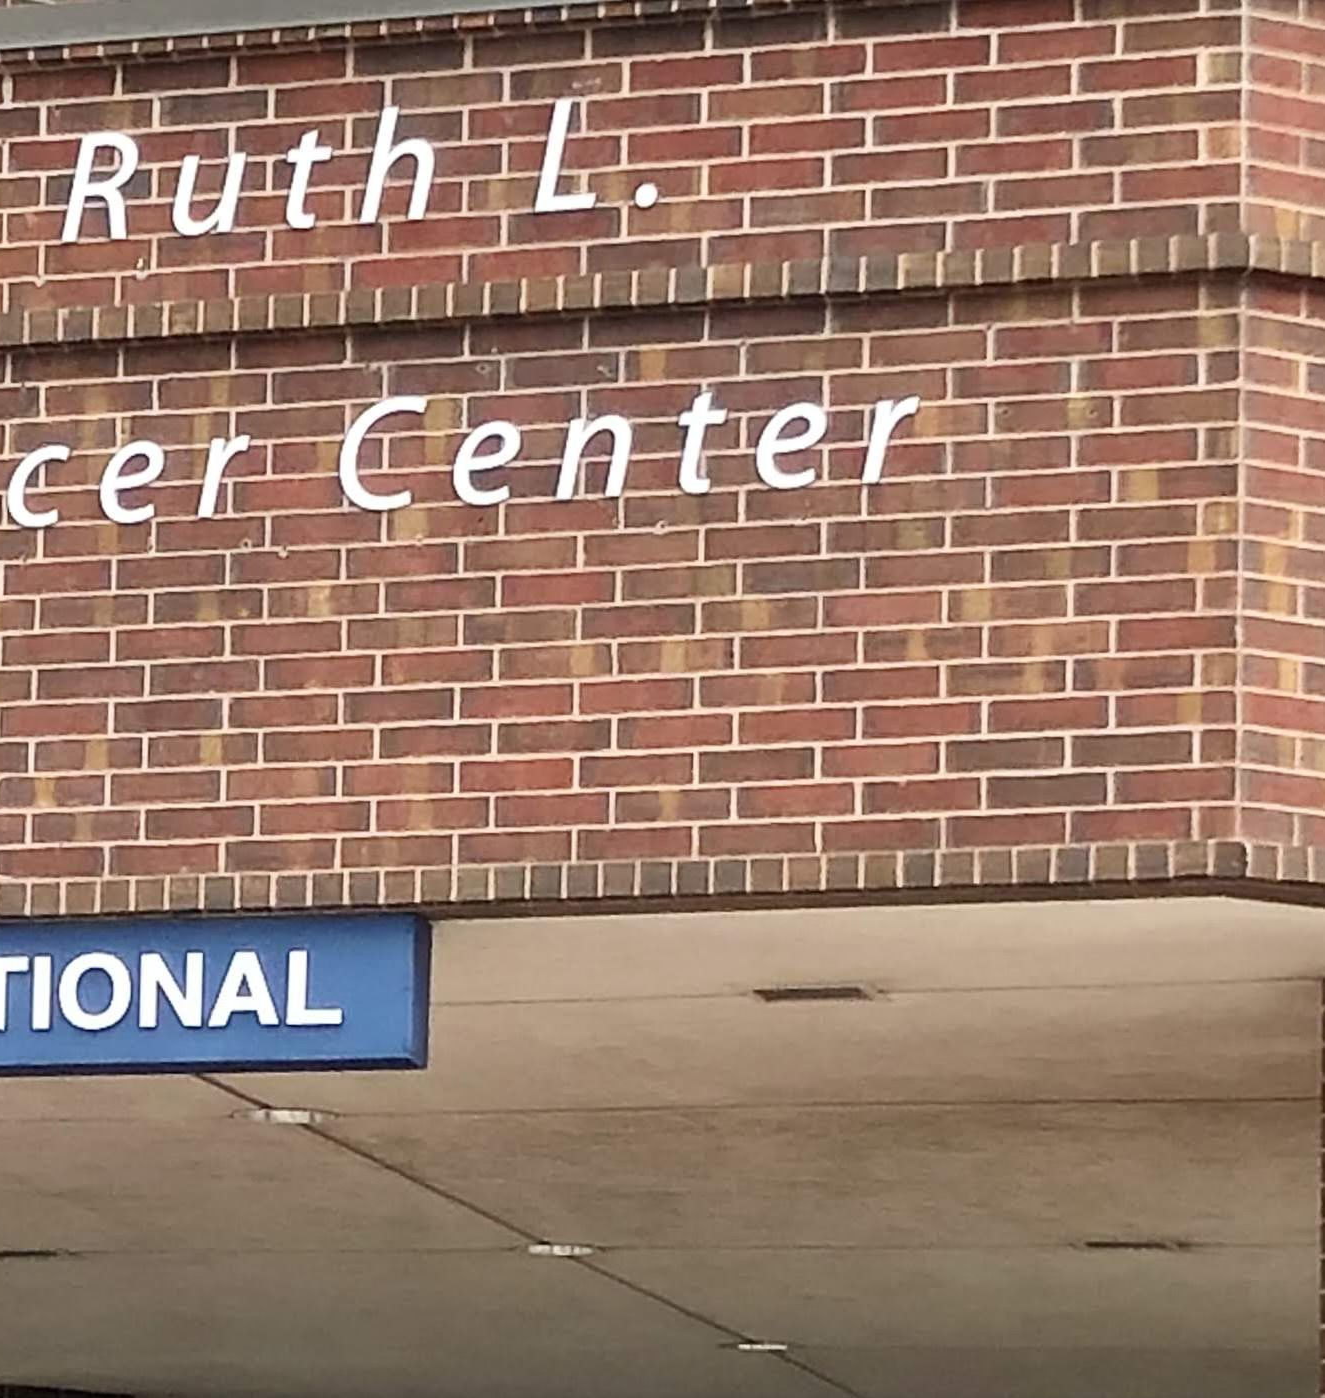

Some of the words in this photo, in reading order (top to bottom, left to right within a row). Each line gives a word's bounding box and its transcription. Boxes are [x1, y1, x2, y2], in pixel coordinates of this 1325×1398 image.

[63, 107, 435, 243] Ruth
[536, 99, 658, 213] L.
[340, 393, 921, 511] Center
